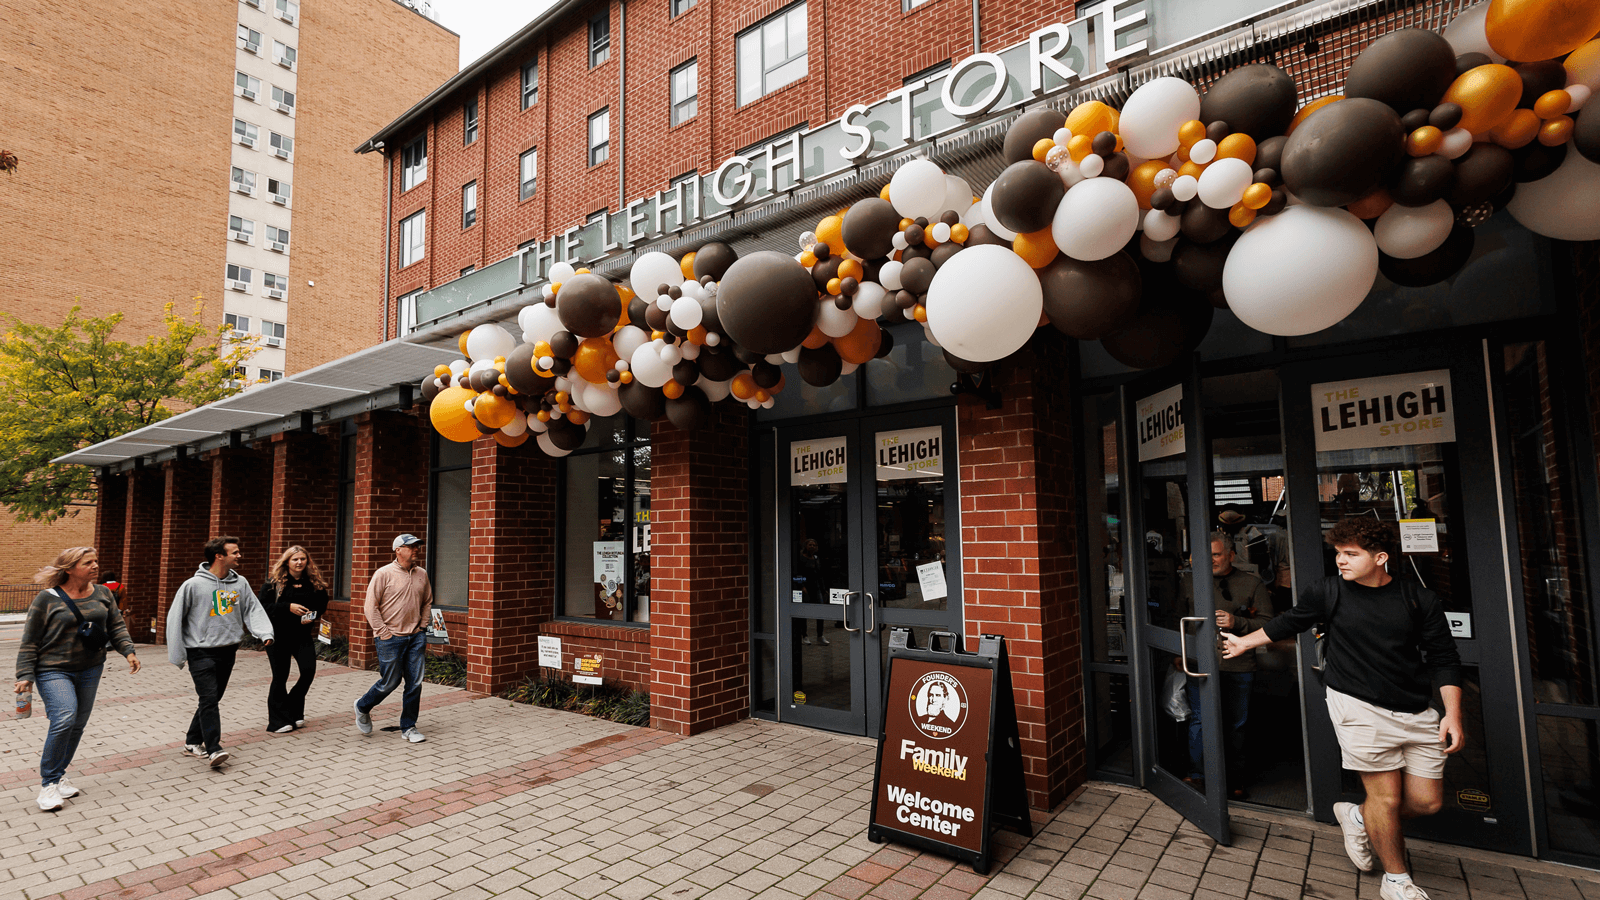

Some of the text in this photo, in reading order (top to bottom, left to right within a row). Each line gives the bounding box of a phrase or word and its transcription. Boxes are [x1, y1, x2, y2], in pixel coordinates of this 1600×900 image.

[513, 0, 1150, 285] THE LEHIGH STORE
[1324, 387, 1360, 403] THE
[1141, 403, 1154, 418] THE
[1320, 385, 1446, 433] LEHIGH
[1140, 398, 1184, 445] LEHIGH
[1379, 417, 1443, 437] STORE
[881, 436, 899, 447] THE
[1160, 428, 1184, 447] STORE
[794, 446, 845, 474] LEHIGH
[796, 445, 811, 455] THE
[879, 437, 940, 467] LEHIGH
[817, 466, 844, 478] STORE
[907, 459, 939, 472] STORE
[921, 673, 958, 688] FOUNDER'S
[921, 722, 952, 735] WEEKEND
[900, 738, 968, 777] Family
[912, 757, 967, 781] Weekend
[887, 784, 975, 822] Welcome
[896, 804, 961, 837] Center
